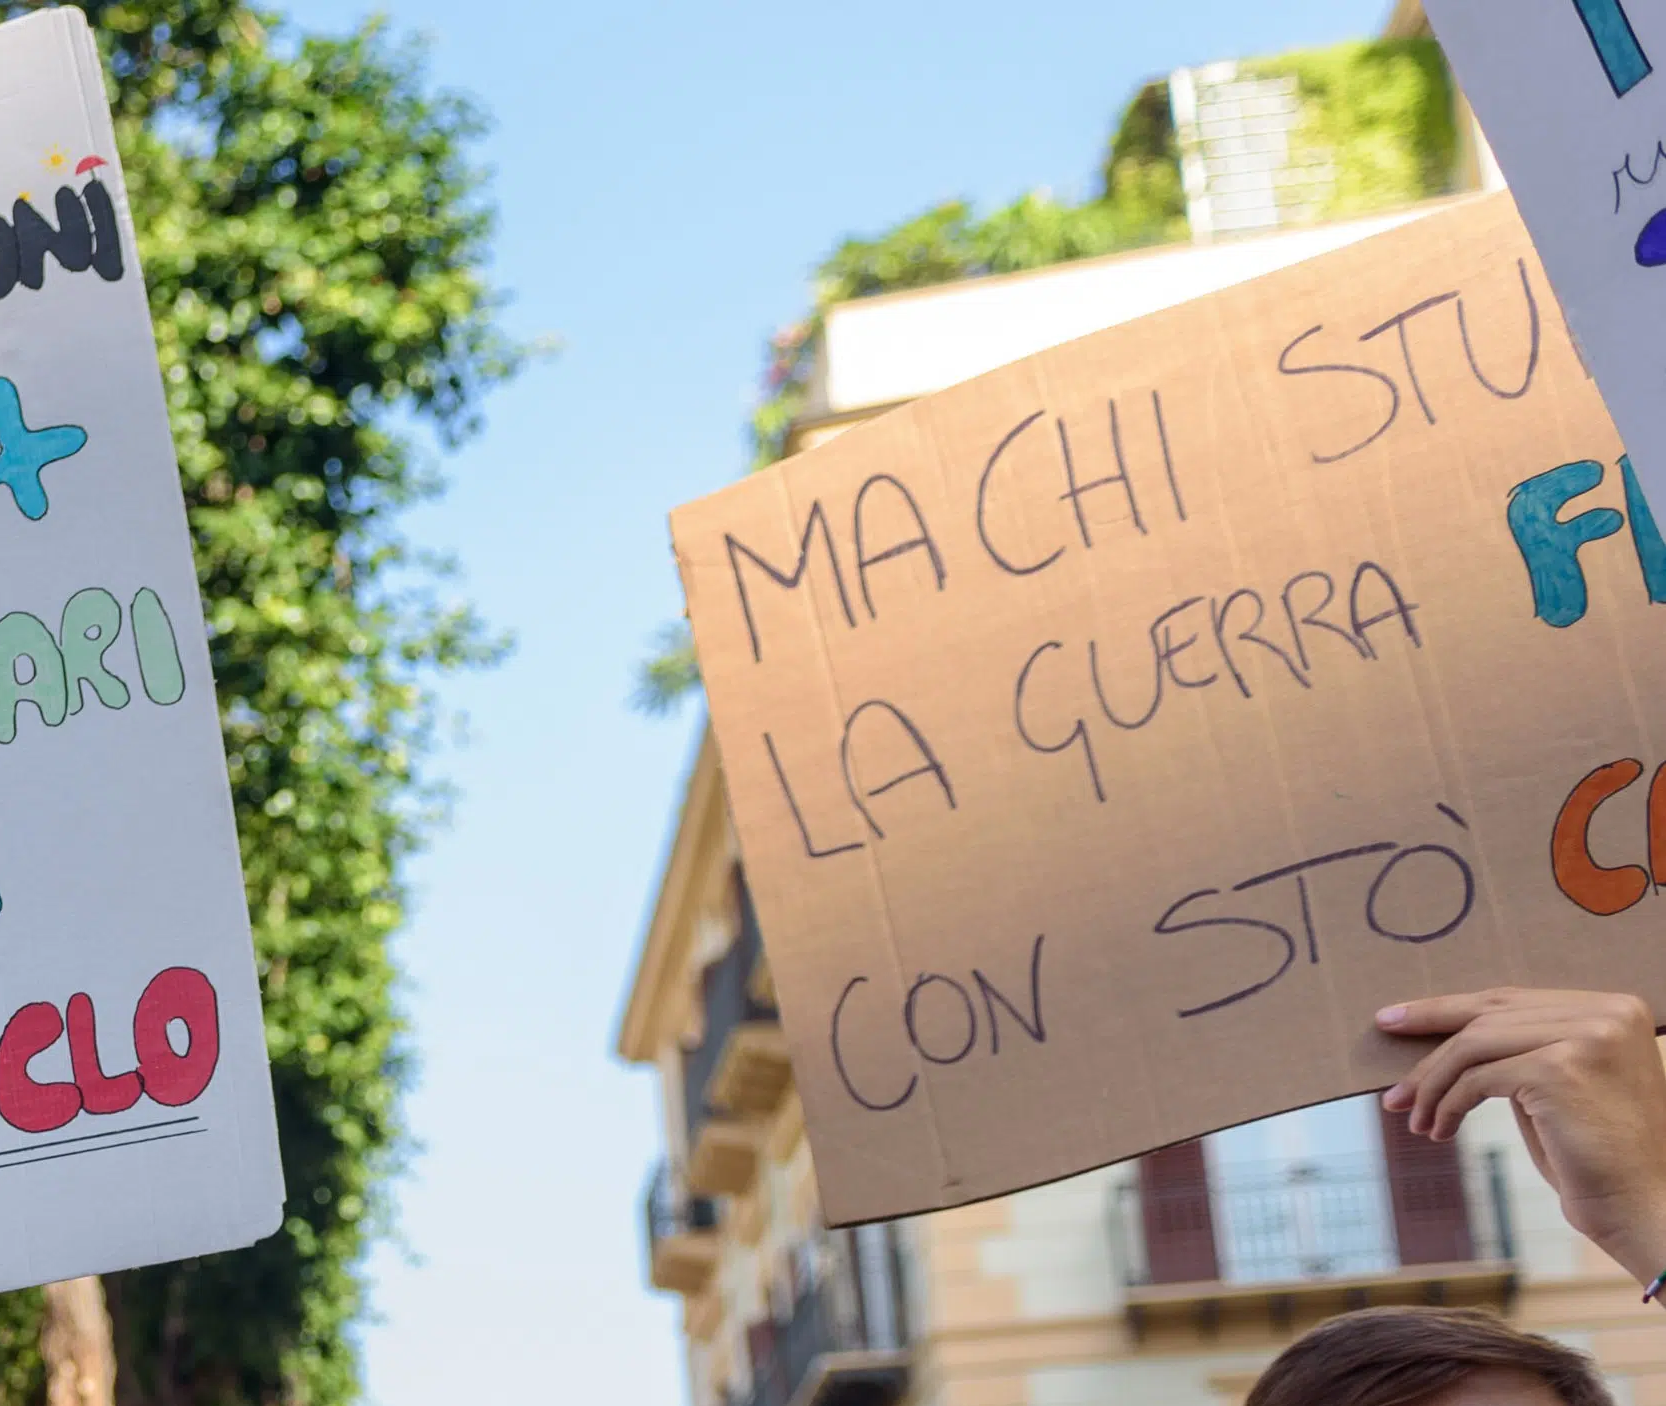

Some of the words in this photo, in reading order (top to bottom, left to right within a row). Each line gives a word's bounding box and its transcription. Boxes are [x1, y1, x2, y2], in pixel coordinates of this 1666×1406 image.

[1277, 258, 1542, 464] STU
[764, 698, 957, 859] LA
[1014, 560, 1422, 804] GUERRA
[831, 932, 1047, 1111] CON
